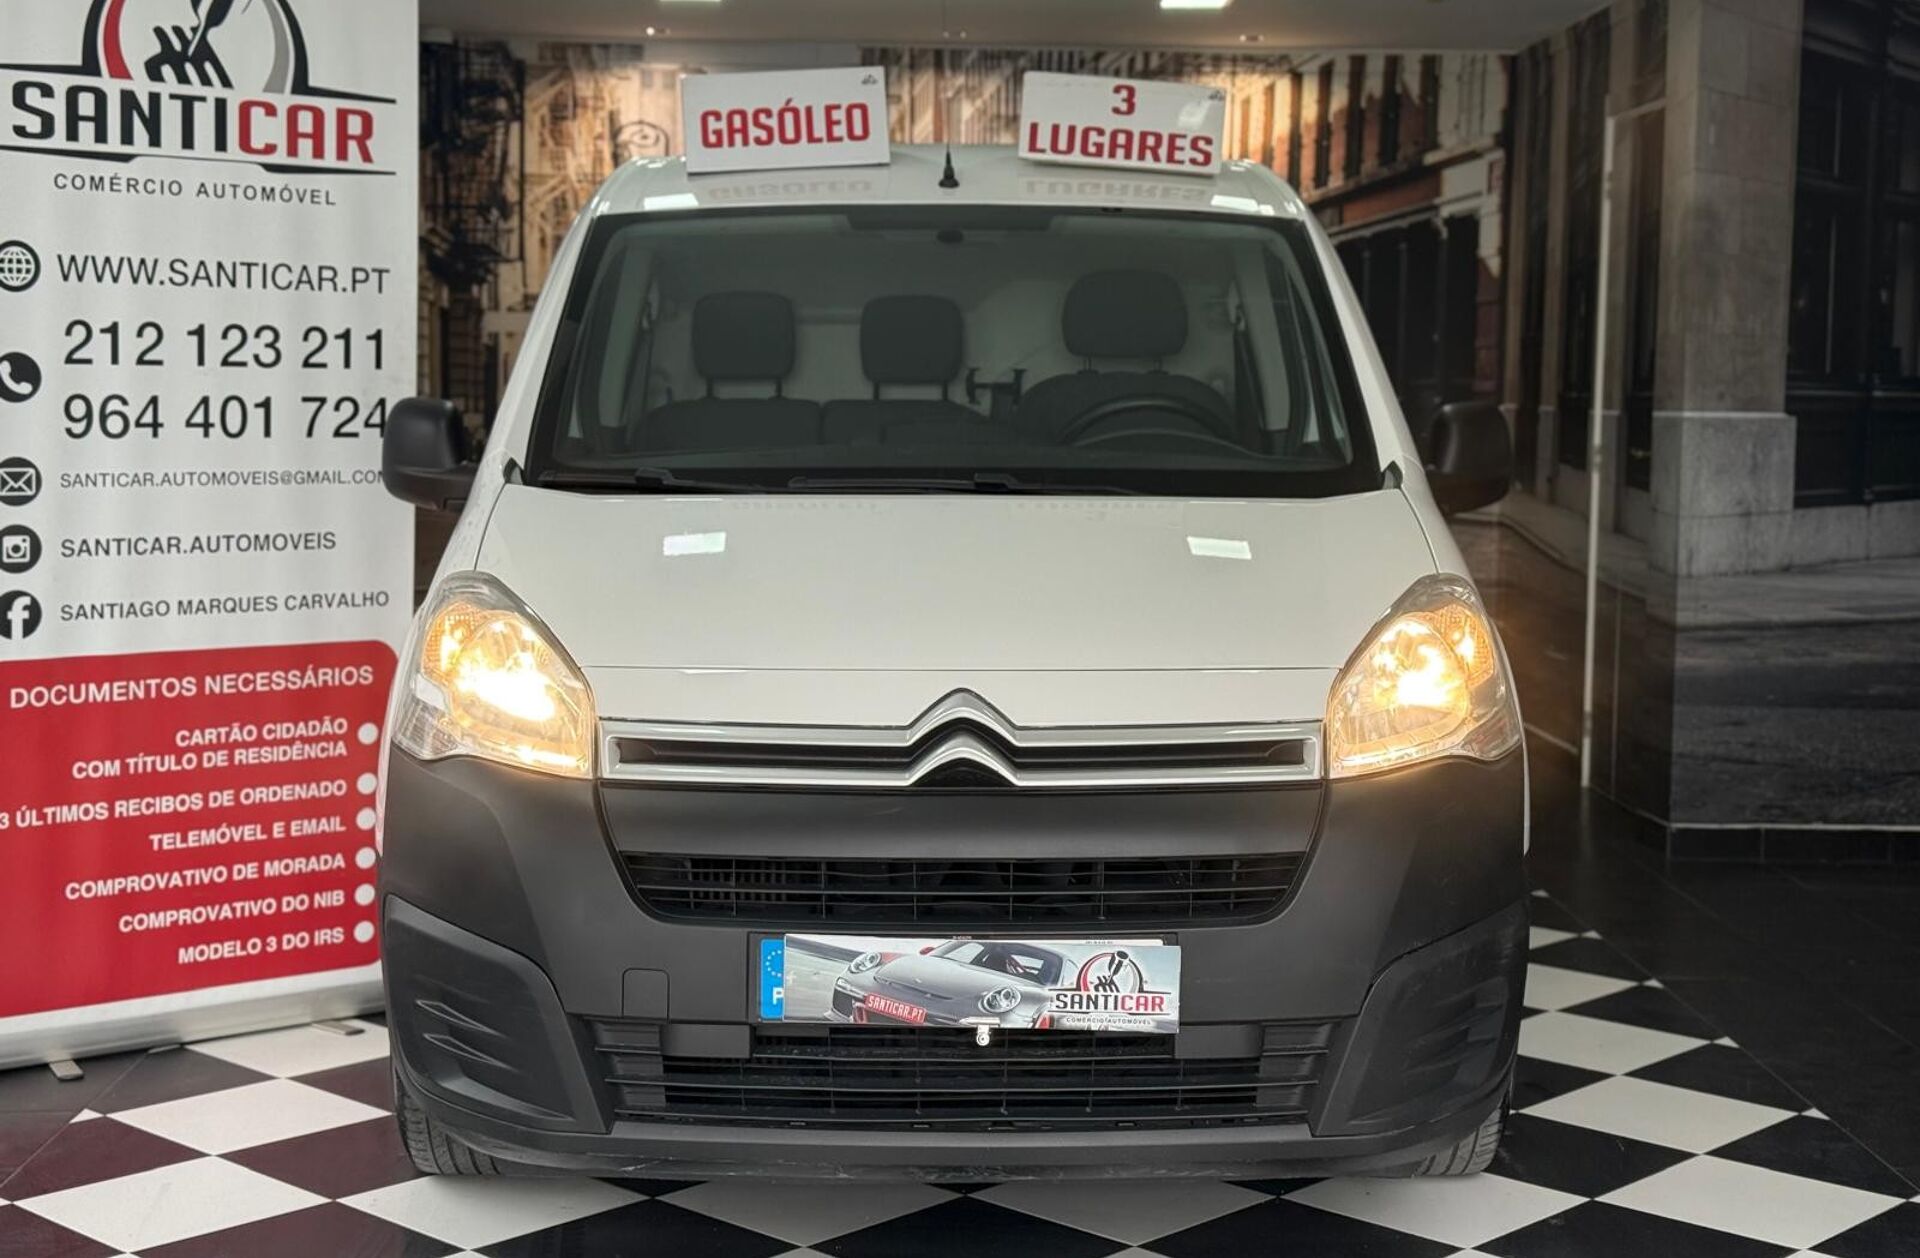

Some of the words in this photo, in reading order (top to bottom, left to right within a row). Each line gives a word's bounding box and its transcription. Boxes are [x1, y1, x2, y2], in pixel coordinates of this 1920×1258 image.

[1111, 84, 1136, 116] 3
[12, 80, 374, 164] SANTICAR
[701, 98, 870, 149] GASÓLEO
[1026, 122, 1213, 168] LUGARES
[54, 172, 183, 197] COMÉRCIO
[196, 183, 336, 206] AUTOMÓVEL
[57, 254, 390, 294] WWW.SANTICAR.PT
[64, 319, 164, 366] 212
[187, 323, 282, 369] 123
[301, 326, 383, 370] 211
[63, 394, 164, 439] 964
[185, 395, 272, 439] 401
[301, 396, 386, 438] 724
[60, 531, 336, 558] SANTICAR.AUTOMOVEIS
[60, 600, 170, 621] SANTIAGO
[177, 596, 278, 617] MARQUES
[284, 591, 389, 611] CARVALHO
[10, 677, 197, 709] DOCUMENTOS
[204, 665, 373, 695] NECESSÁRIOS
[176, 723, 257, 748] CARTÃO
[262, 716, 348, 741] CIDADÃO
[72, 761, 120, 779] COM
[126, 752, 197, 774] TÍTULO
[203, 751, 228, 768] DE
[234, 740, 347, 765] RESIDÊNCIA
[0, 812, 9, 829] 3
[16, 803, 109, 828] ÚLTIMOS
[114, 793, 203, 819] RECIBOS
[208, 791, 234, 808] DE
[239, 779, 347, 806] ORDENADO
[149, 822, 267, 851] TELEMÓVEL
[273, 820, 285, 838] E
[290, 815, 346, 837] EMAIL
[65, 865, 228, 901] COMPROVATIVO
[232, 863, 259, 881] DE
[264, 853, 346, 878] MORADA
[119, 897, 277, 933] COMPROVATIVO
[281, 894, 308, 913] DO
[314, 890, 345, 909] NIB
[178, 938, 262, 965] MODELO
[265, 935, 277, 952] 3
[282, 931, 309, 950] DO
[314, 928, 344, 947] IRS
[772, 986, 784, 1005] P
[868, 995, 924, 1021] SANTICAR.PT
[1055, 993, 1165, 1012] SANTICAR
